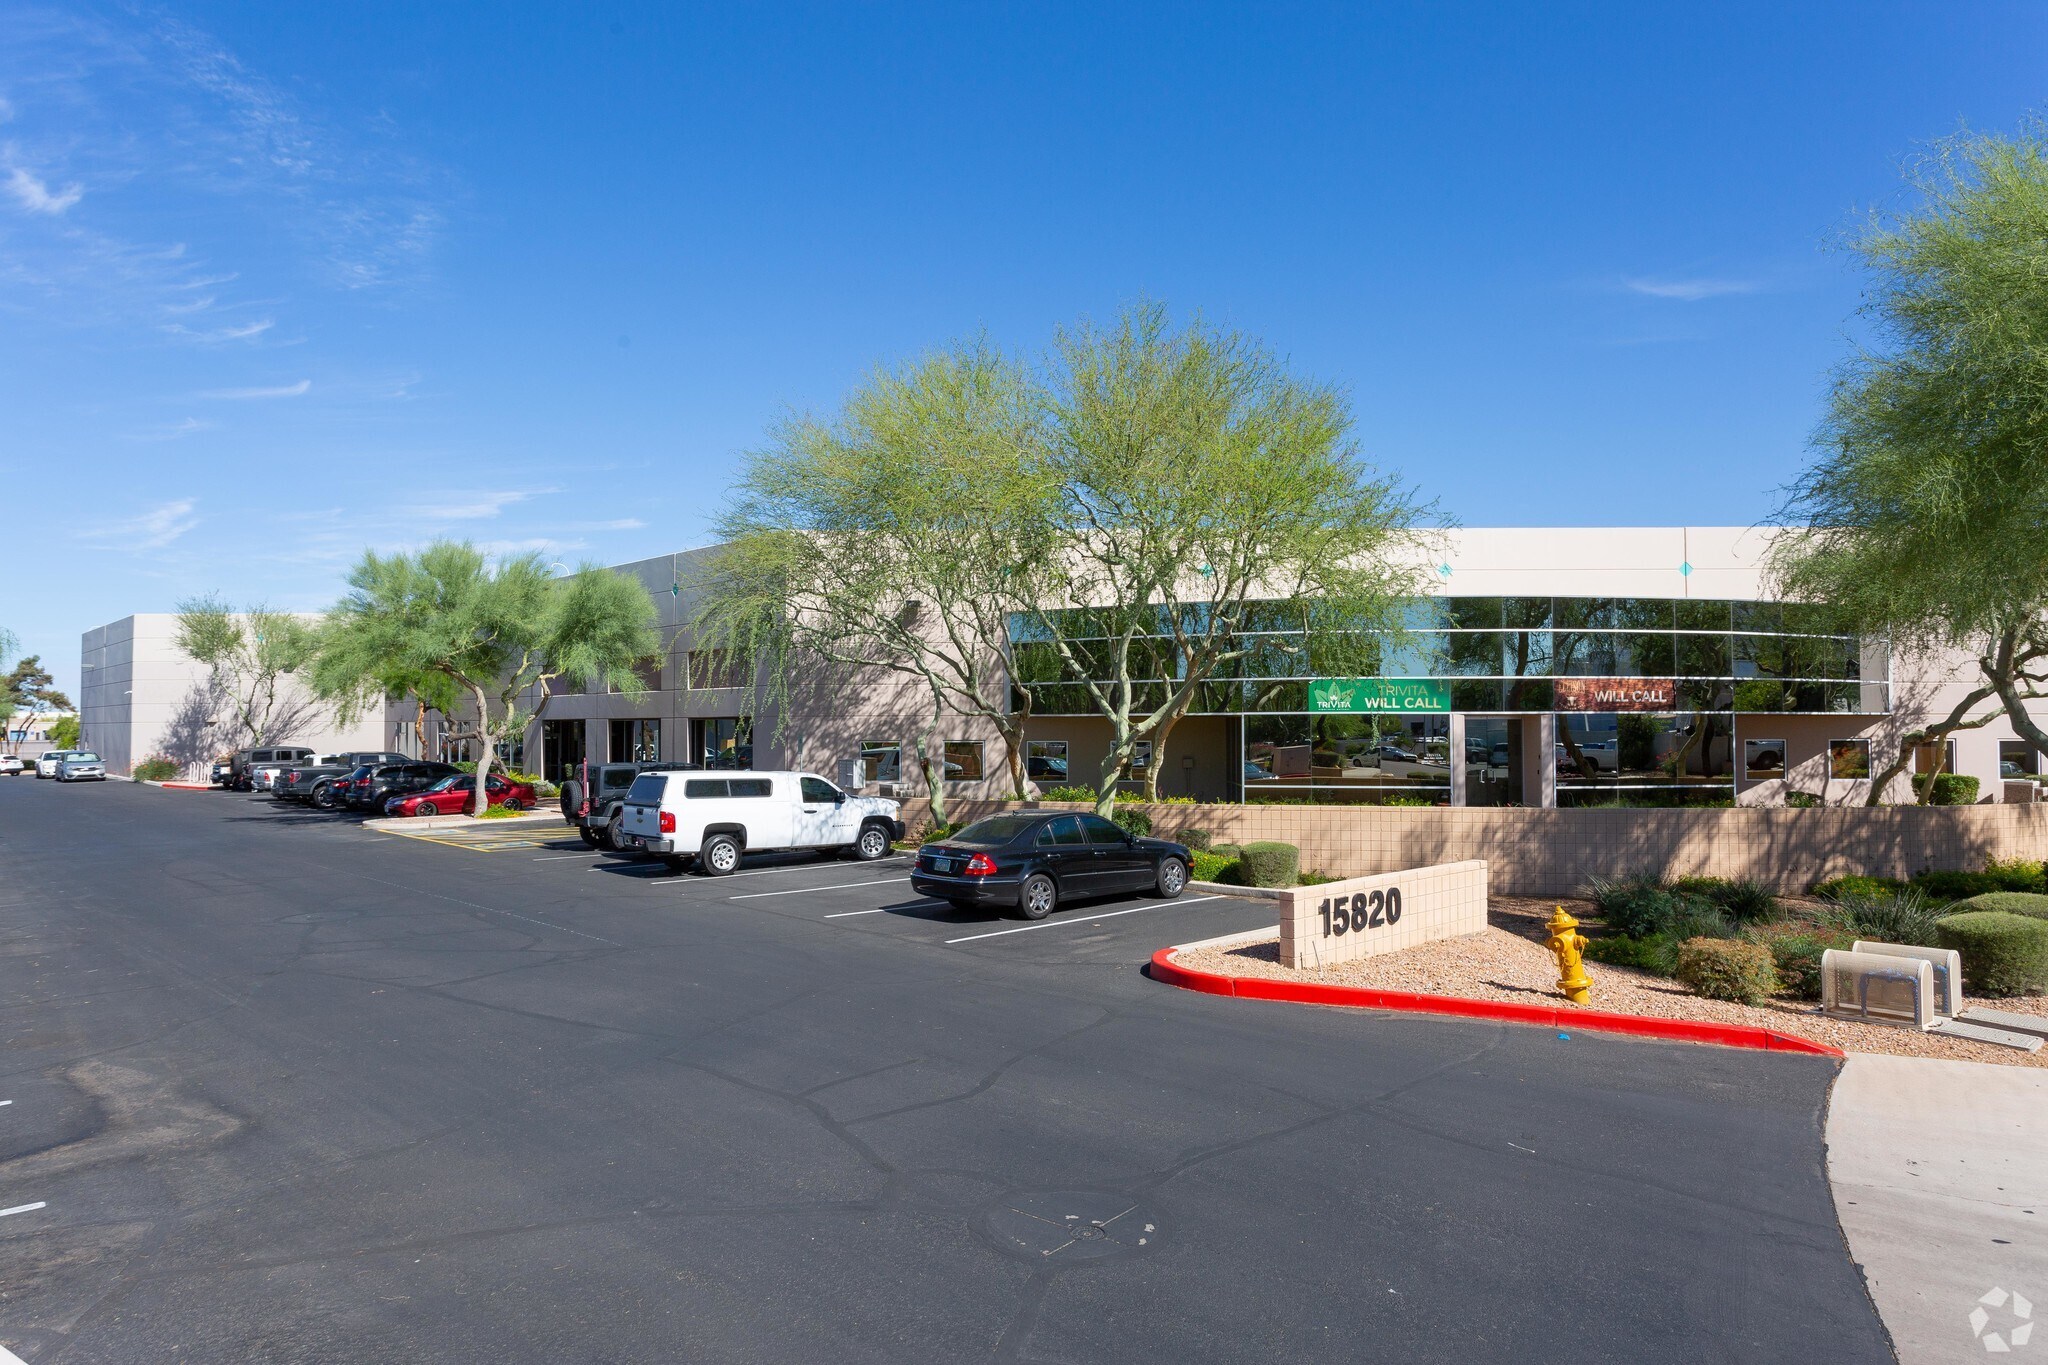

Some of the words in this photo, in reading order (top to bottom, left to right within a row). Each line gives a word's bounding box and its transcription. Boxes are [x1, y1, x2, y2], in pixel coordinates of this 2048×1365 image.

[1379, 685, 1428, 697] TRIVITA
[1594, 690, 1629, 703] WILL
[1632, 690, 1668, 703] CALL
[1316, 700, 1352, 709] TRIVITA
[1364, 697, 1401, 709] WILL
[1404, 697, 1442, 709] CALL
[1318, 887, 1402, 939] 15820
